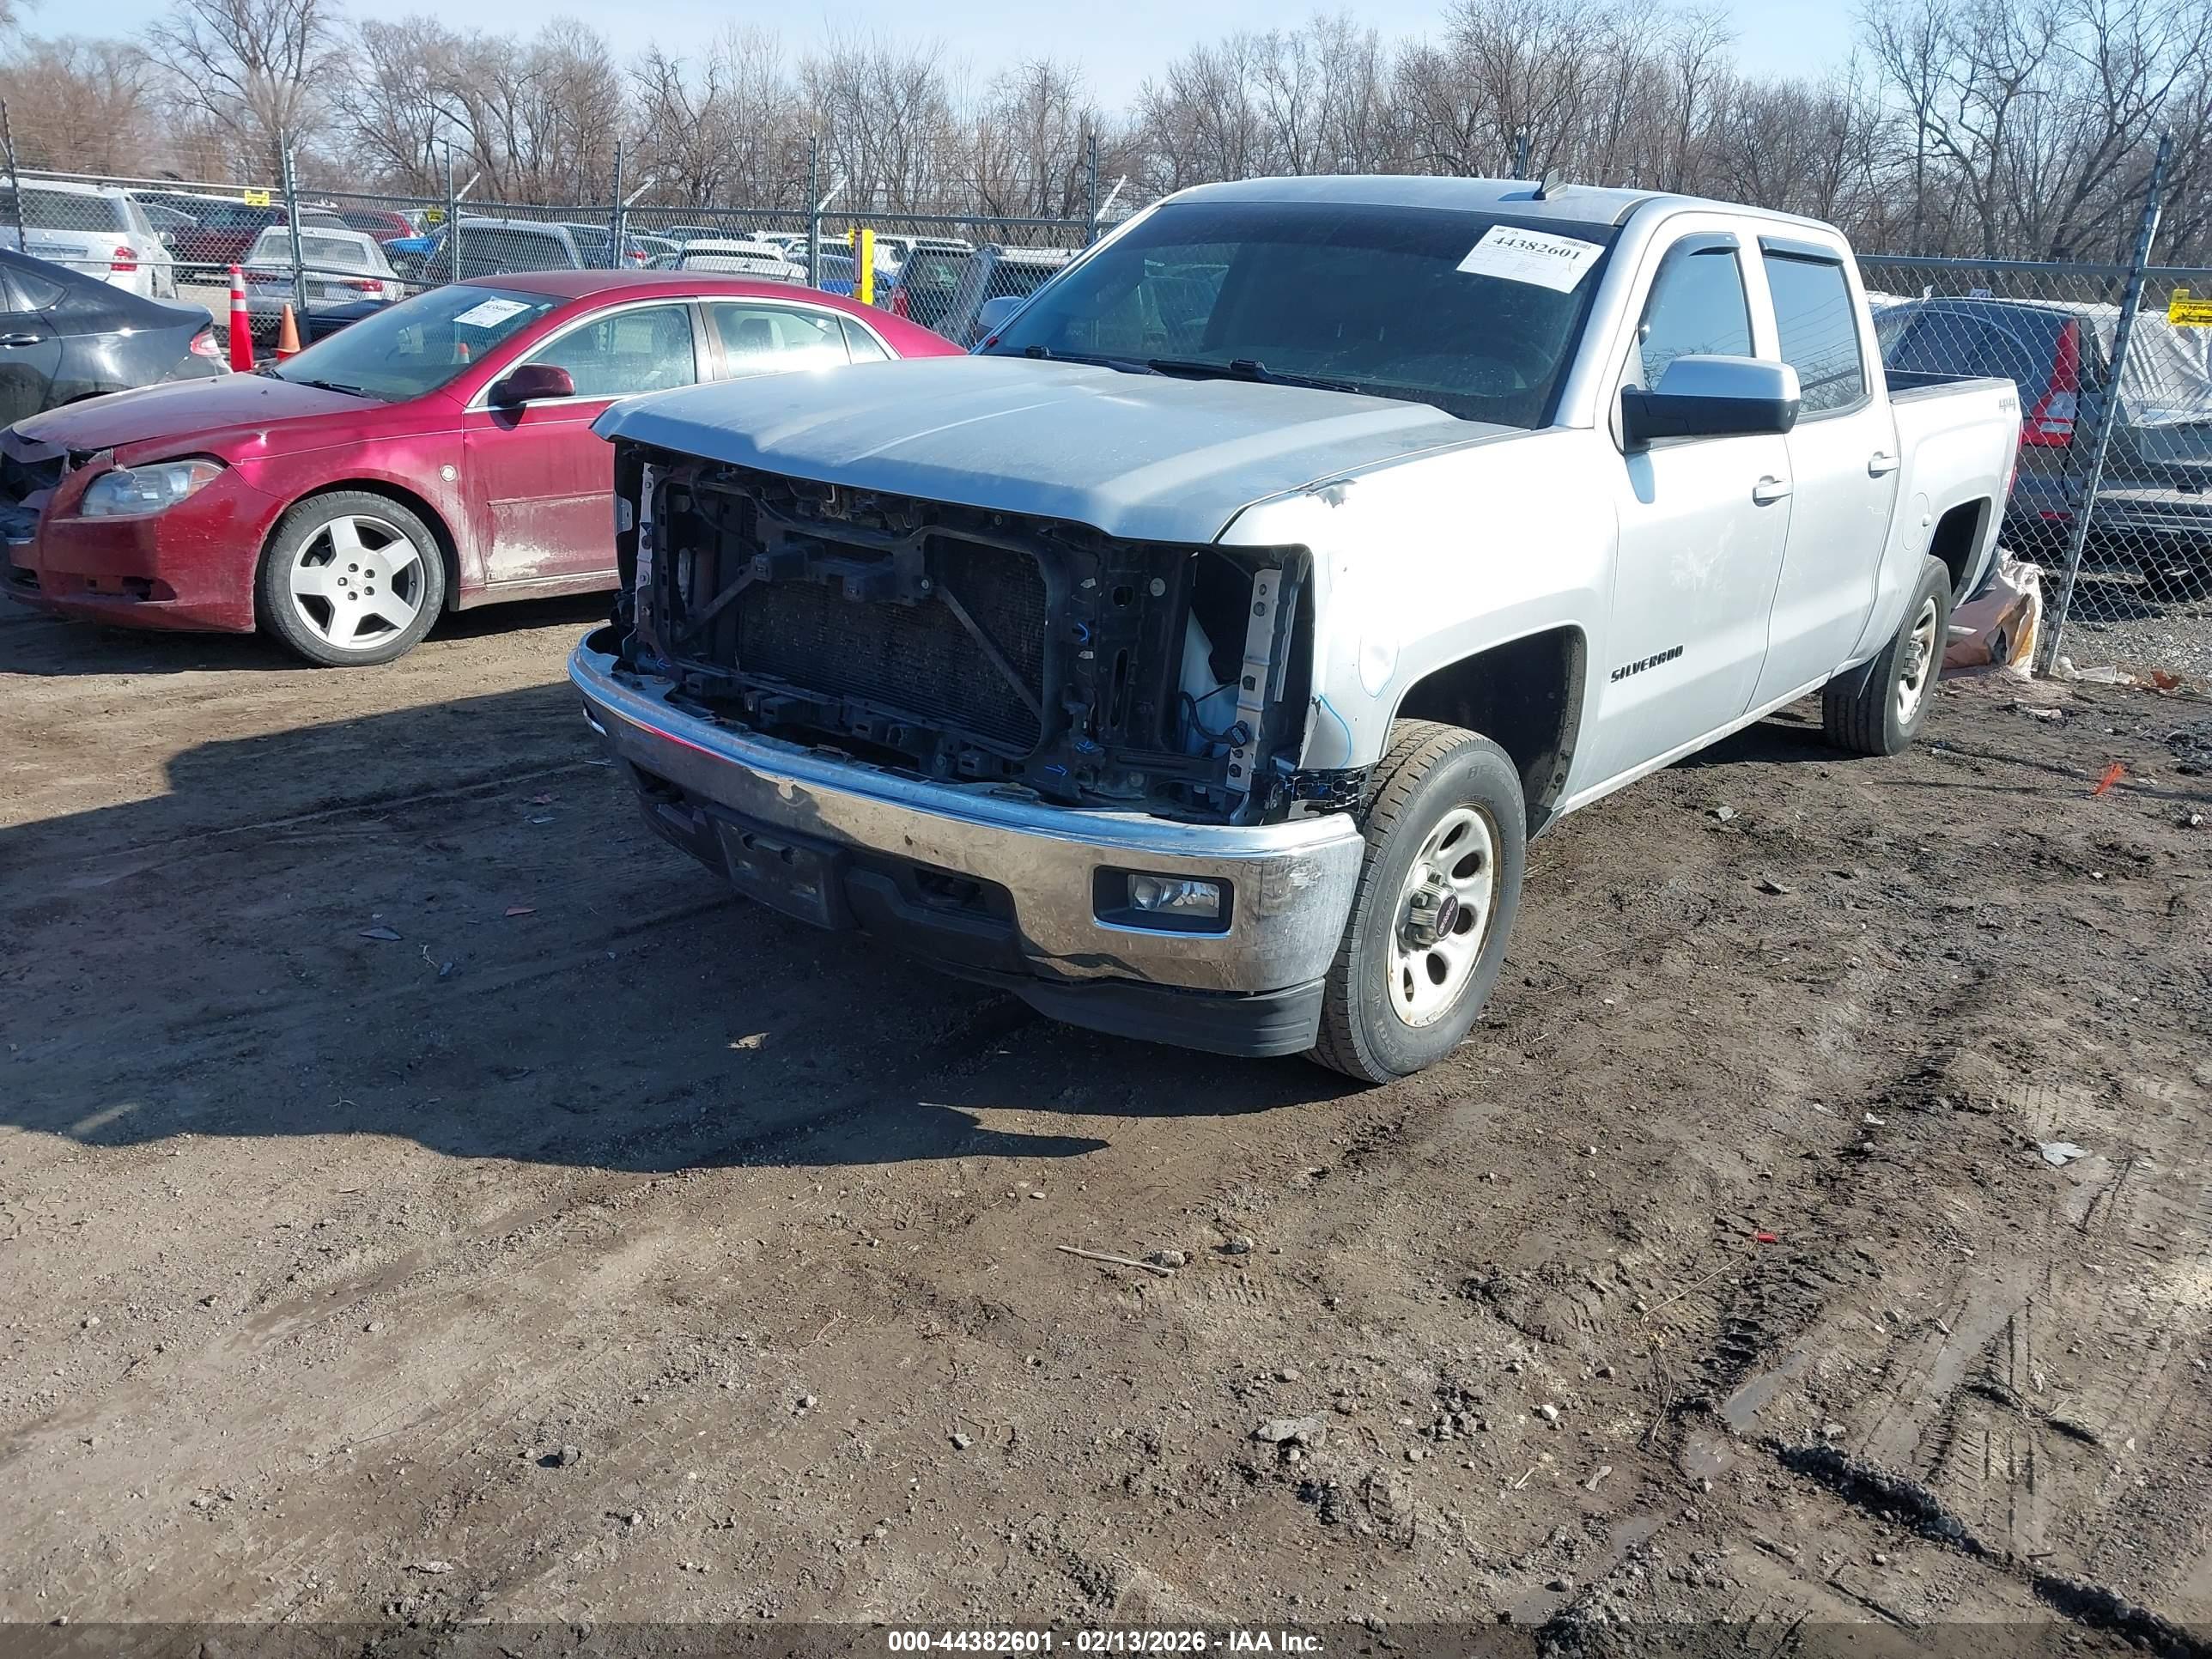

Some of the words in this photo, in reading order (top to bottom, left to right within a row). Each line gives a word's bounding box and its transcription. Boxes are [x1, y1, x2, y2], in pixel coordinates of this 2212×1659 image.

[1492, 236, 1581, 260] 44382601
[1610, 645, 1684, 684] SILVERADO
[1438, 898, 1456, 935] GMC
